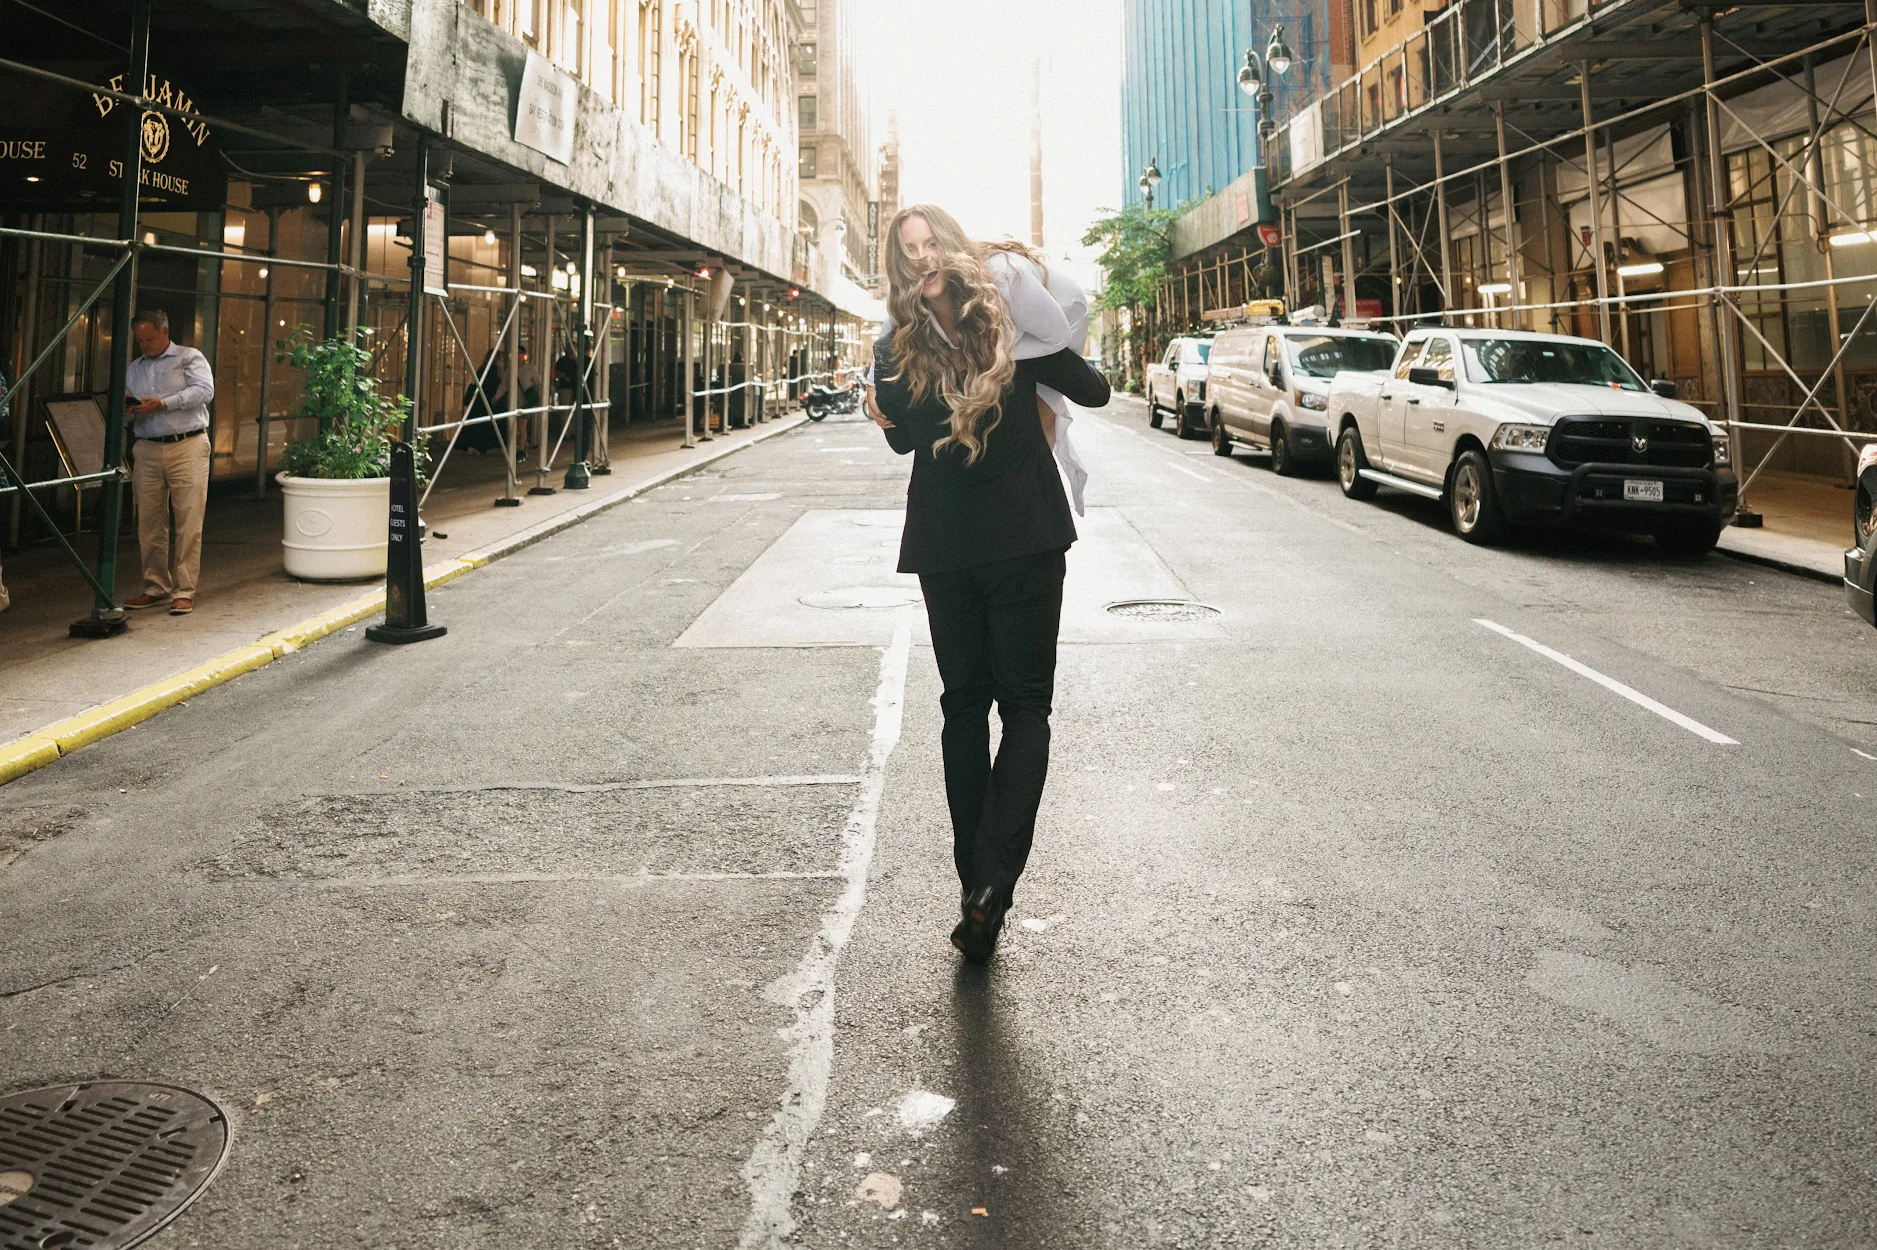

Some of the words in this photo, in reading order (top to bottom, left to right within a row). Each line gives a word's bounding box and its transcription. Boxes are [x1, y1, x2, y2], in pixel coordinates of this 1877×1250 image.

[92, 74, 210, 147] BEJAMIN
[72, 152, 87, 170] 52
[108, 159, 150, 186] STK
[152, 171, 189, 196] HOUSE
[390, 533, 403, 542] ONLY
